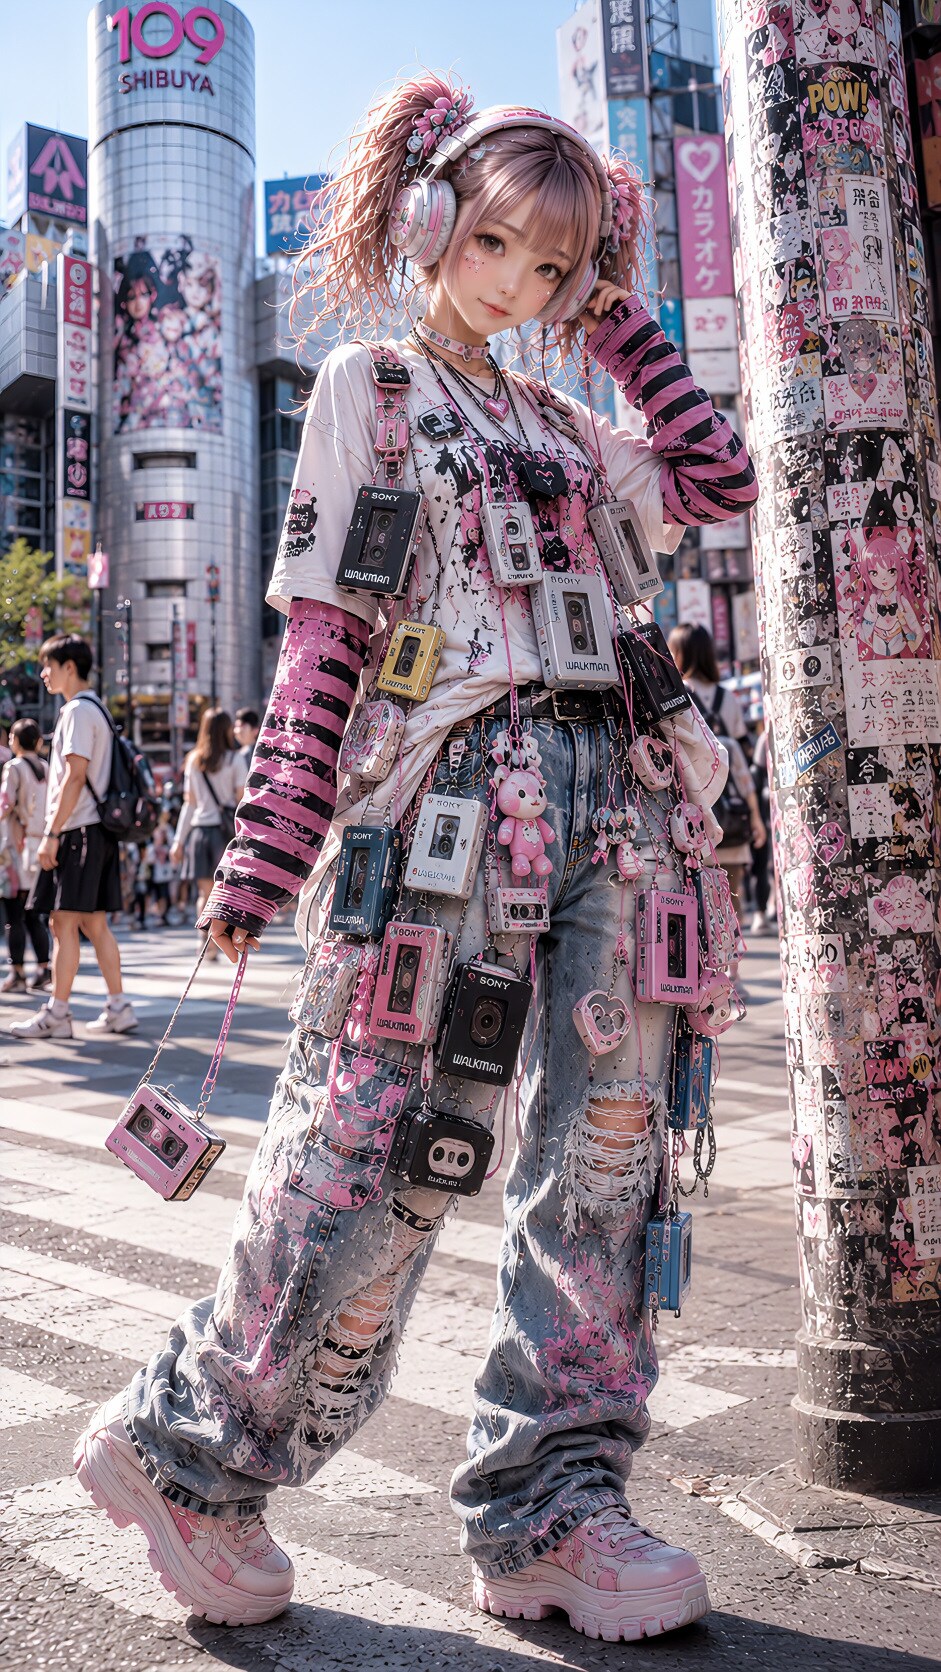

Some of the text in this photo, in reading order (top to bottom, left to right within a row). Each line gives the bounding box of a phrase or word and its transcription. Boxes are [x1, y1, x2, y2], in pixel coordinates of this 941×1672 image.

[106, 2, 226, 64] 109
[118, 69, 215, 96] SHIBUYA
[807, 80, 869, 114] POW!
[691, 186, 720, 292] カラオケ
[371, 492, 400, 502] SONY
[344, 568, 390, 585] WALKMAN
[565, 661, 610, 672] WALKMAN
[352, 832, 373, 840] SONY
[399, 928, 425, 938] SONY
[479, 976, 511, 990] SONY
[452, 1053, 503, 1075] WALKMAN
